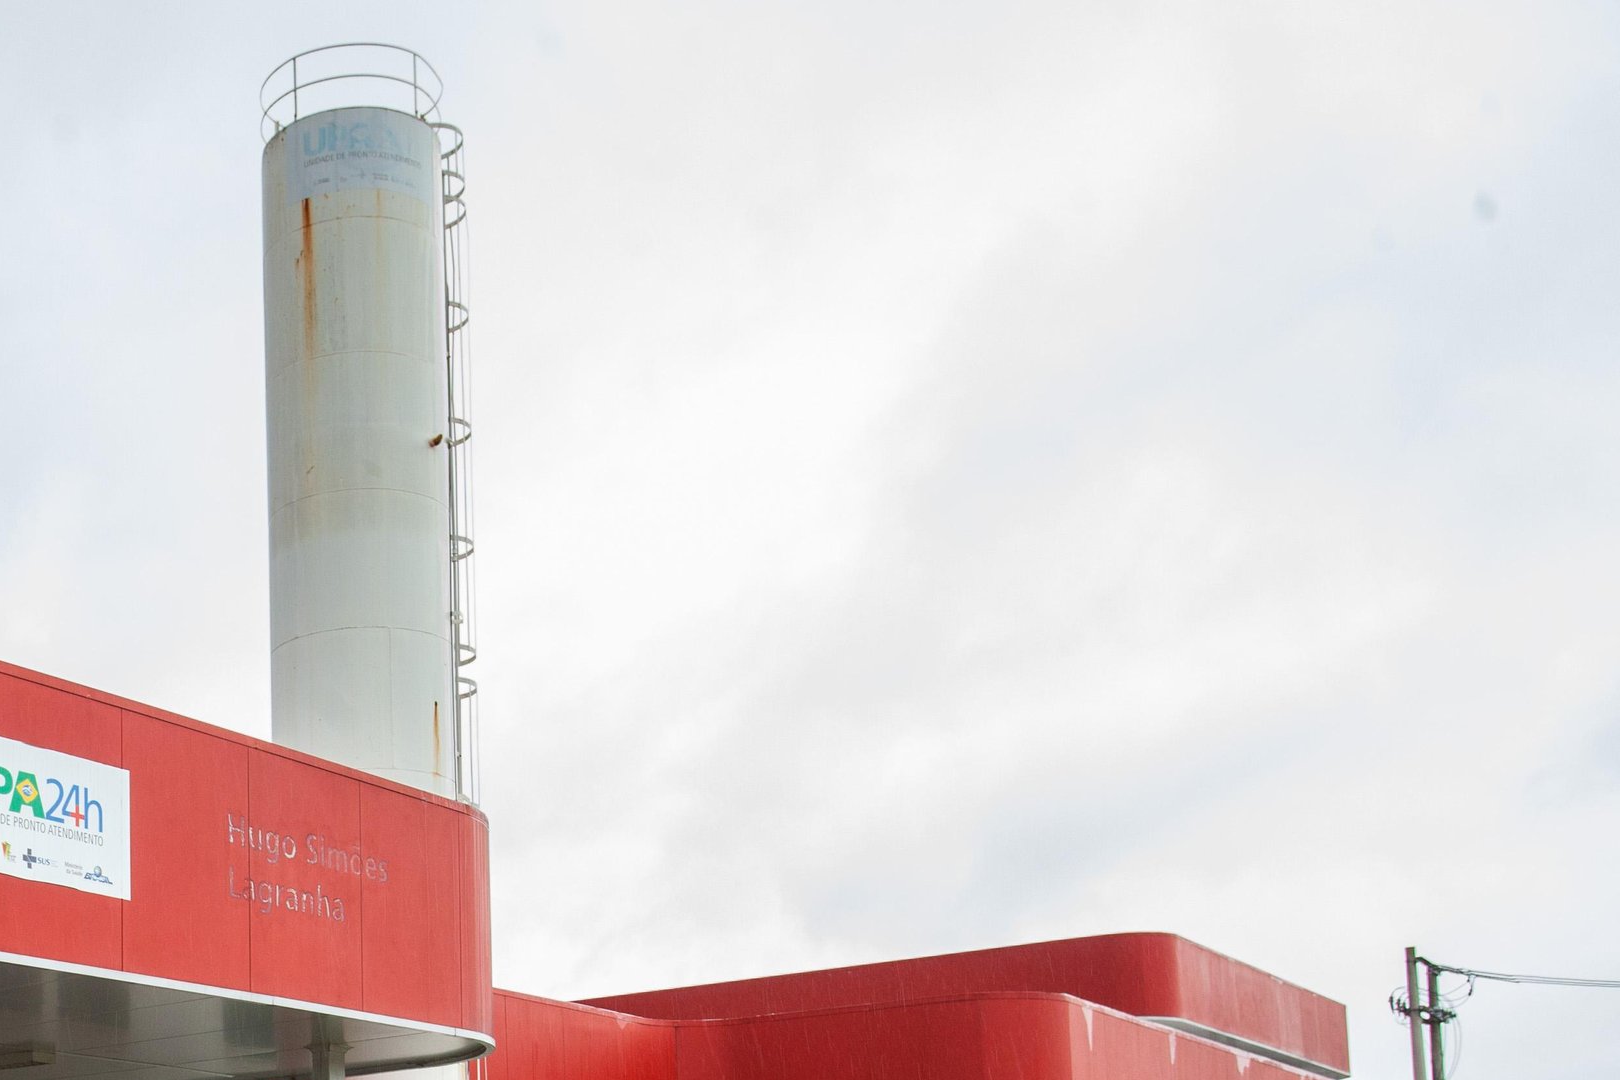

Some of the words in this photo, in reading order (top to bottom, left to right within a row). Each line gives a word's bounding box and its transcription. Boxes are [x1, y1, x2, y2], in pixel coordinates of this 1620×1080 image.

[0, 812, 11, 826] DE
[13, 815, 46, 834] PRONTO
[48, 825, 104, 847] ATENDIMENTO
[46, 778, 103, 833] 24h
[37, 857, 51, 866] SUS
[227, 814, 297, 864] Hugo
[306, 832, 388, 882] Simões
[229, 867, 345, 922] Lagranha
